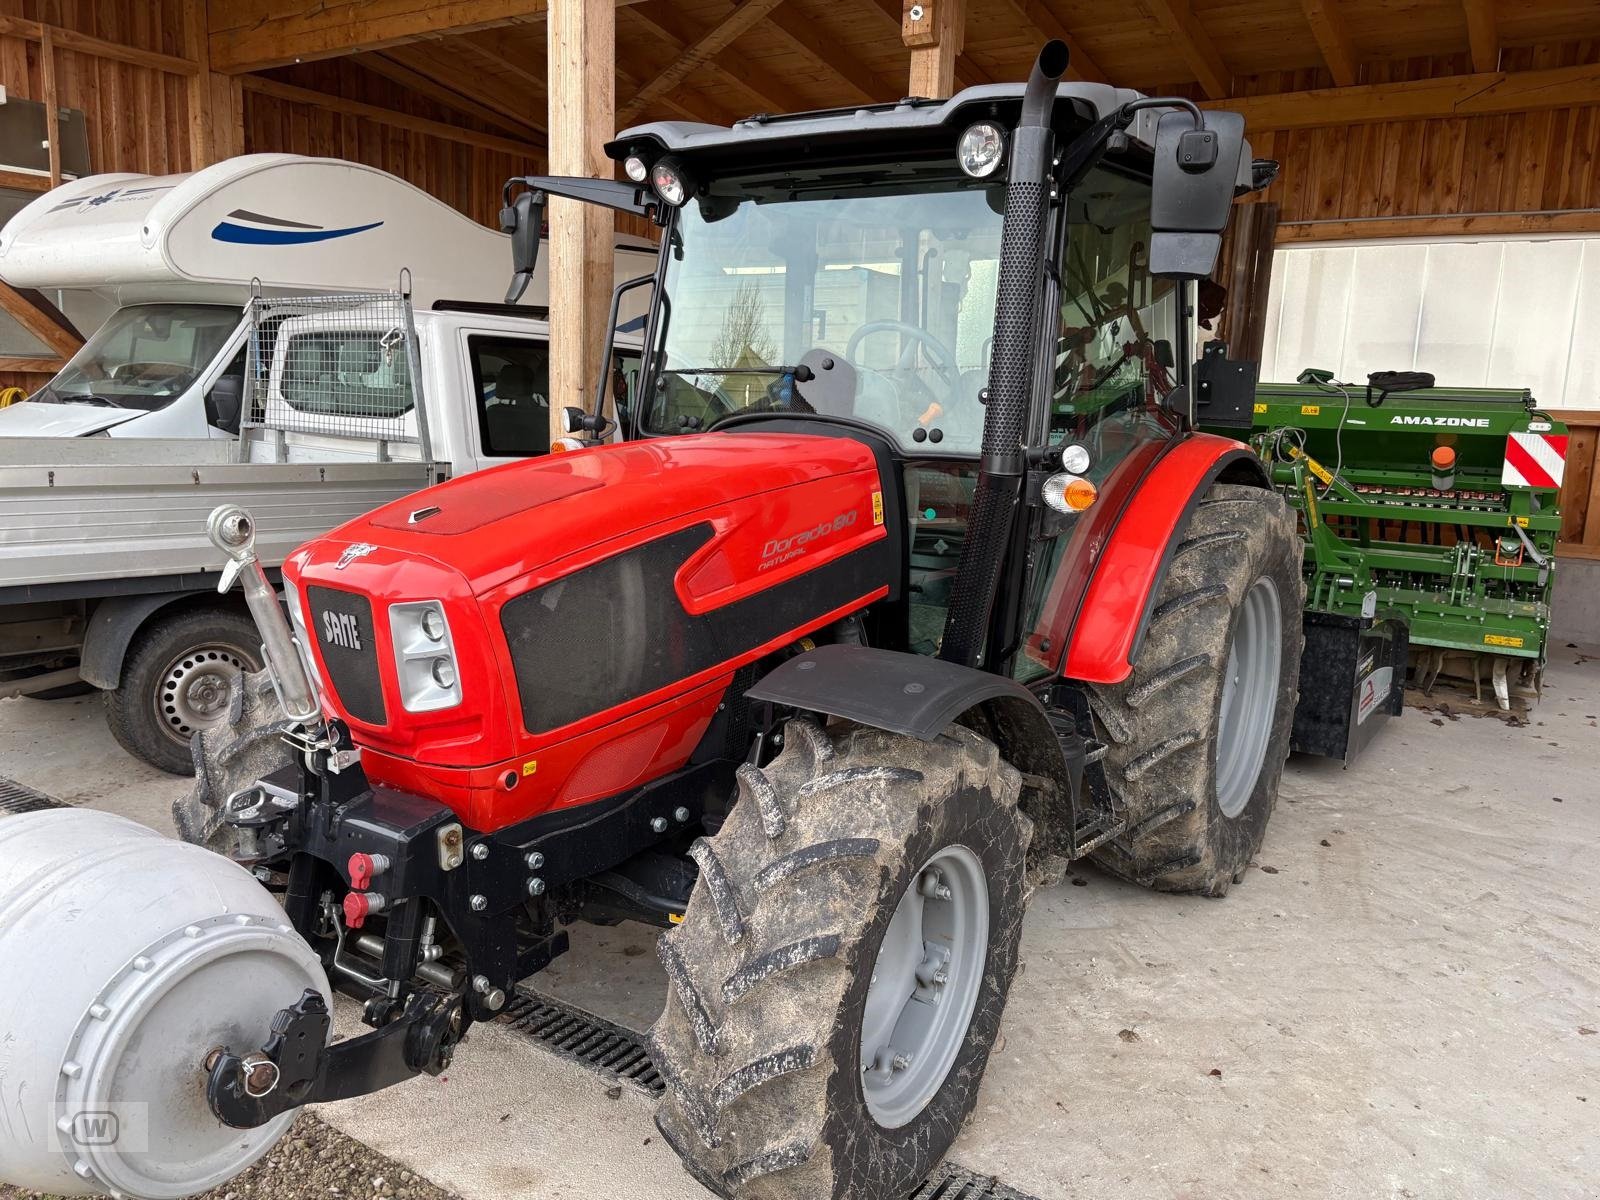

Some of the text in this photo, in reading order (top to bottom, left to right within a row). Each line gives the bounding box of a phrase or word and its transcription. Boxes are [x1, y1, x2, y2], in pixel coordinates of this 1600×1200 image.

[1390, 415, 1490, 427] AMAZONE
[762, 523, 832, 558] Dorado
[322, 610, 361, 650] SAME
